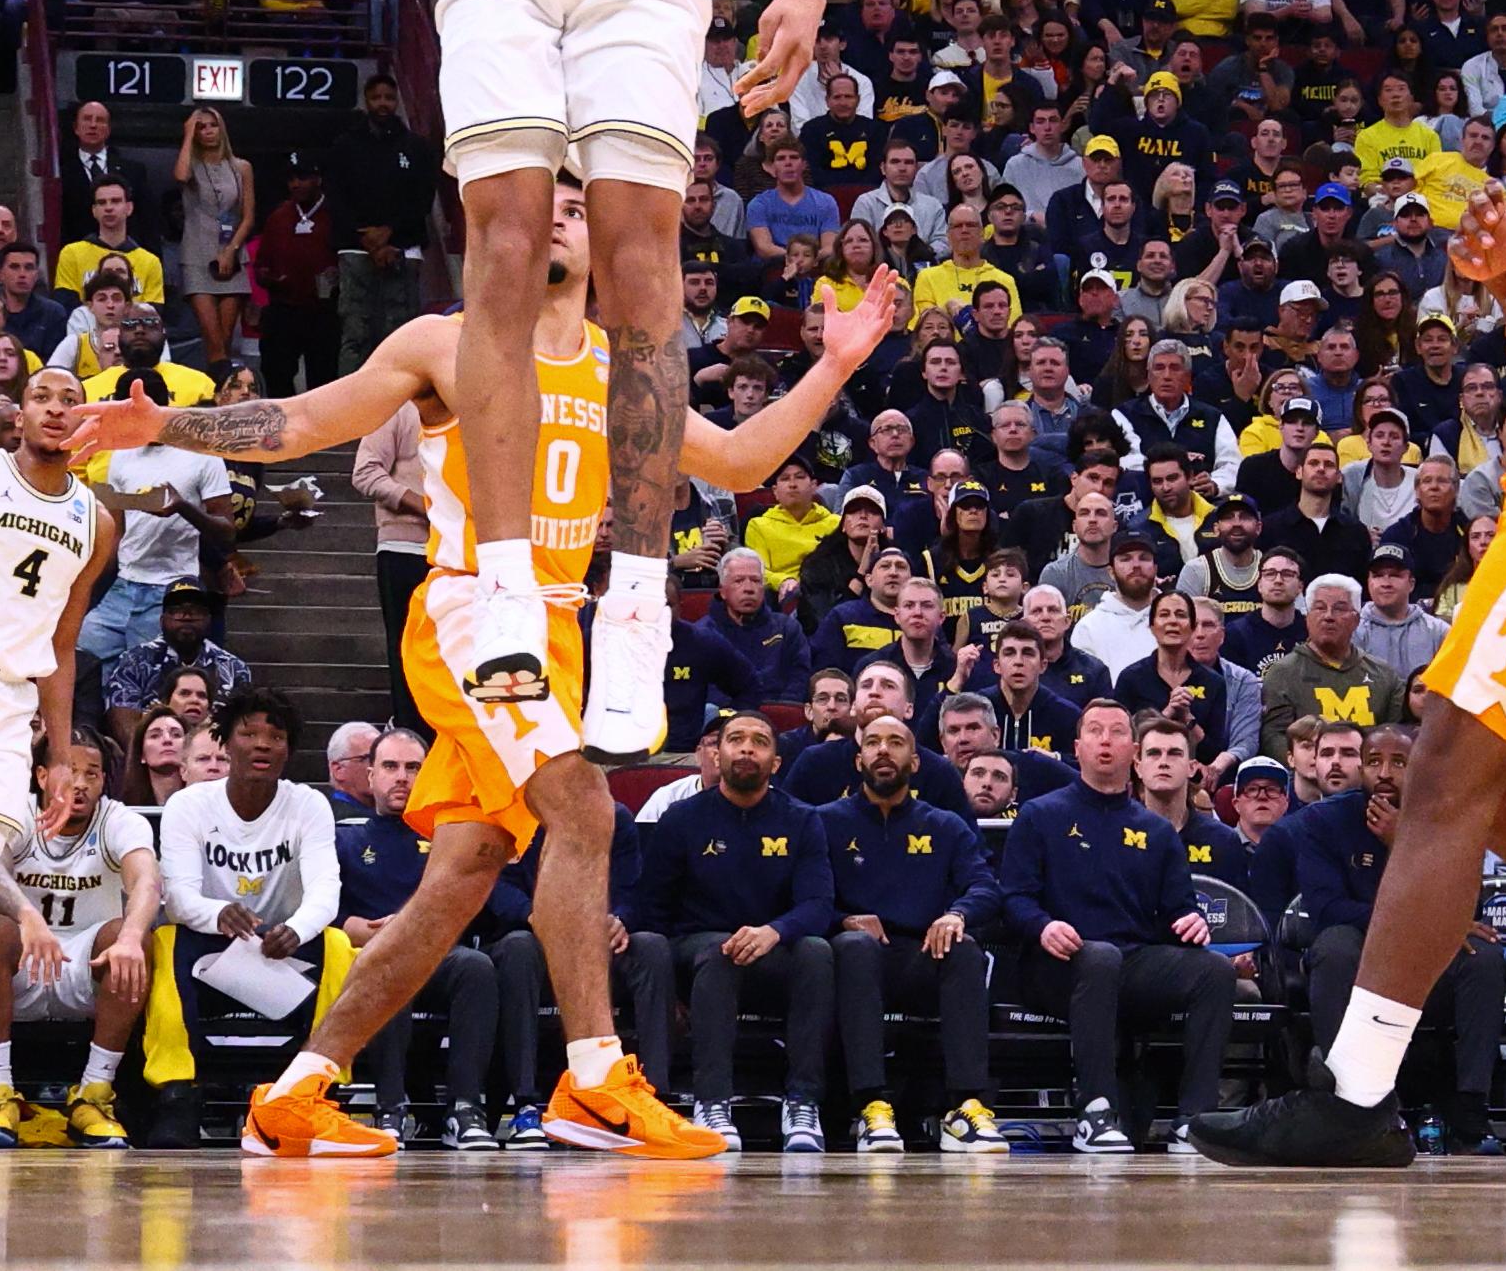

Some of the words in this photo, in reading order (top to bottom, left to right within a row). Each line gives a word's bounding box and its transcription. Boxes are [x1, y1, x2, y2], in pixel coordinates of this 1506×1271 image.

[109, 60, 150, 95] 121
[197, 65, 239, 93] EXIT
[276, 66, 332, 100] 122
[1301, 85, 1336, 101] MICHIG
[829, 140, 867, 170] M
[1139, 136, 1182, 155] HAIL
[1406, 194, 1416, 203] S
[545, 439, 582, 504] 0
[1031, 483, 1045, 491] M
[13, 549, 49, 598] 4
[1258, 653, 1286, 672] MICHI
[674, 667, 690, 679] M
[1071, 675, 1082, 683] M
[1314, 685, 1375, 726] M
[761, 836, 789, 857] M
[907, 834, 932, 854] M
[1124, 828, 1148, 850] M
[206, 841, 252, 873] LOCK
[1189, 845, 1212, 862] M
[16, 871, 102, 890] MICHIGAN
[237, 875, 265, 896] M
[41, 894, 76, 928] 11
[1010, 1012, 1023, 1020] THE
[1024, 1014, 1044, 1022] ROAD
[1251, 1011, 1271, 1021] FOUR
